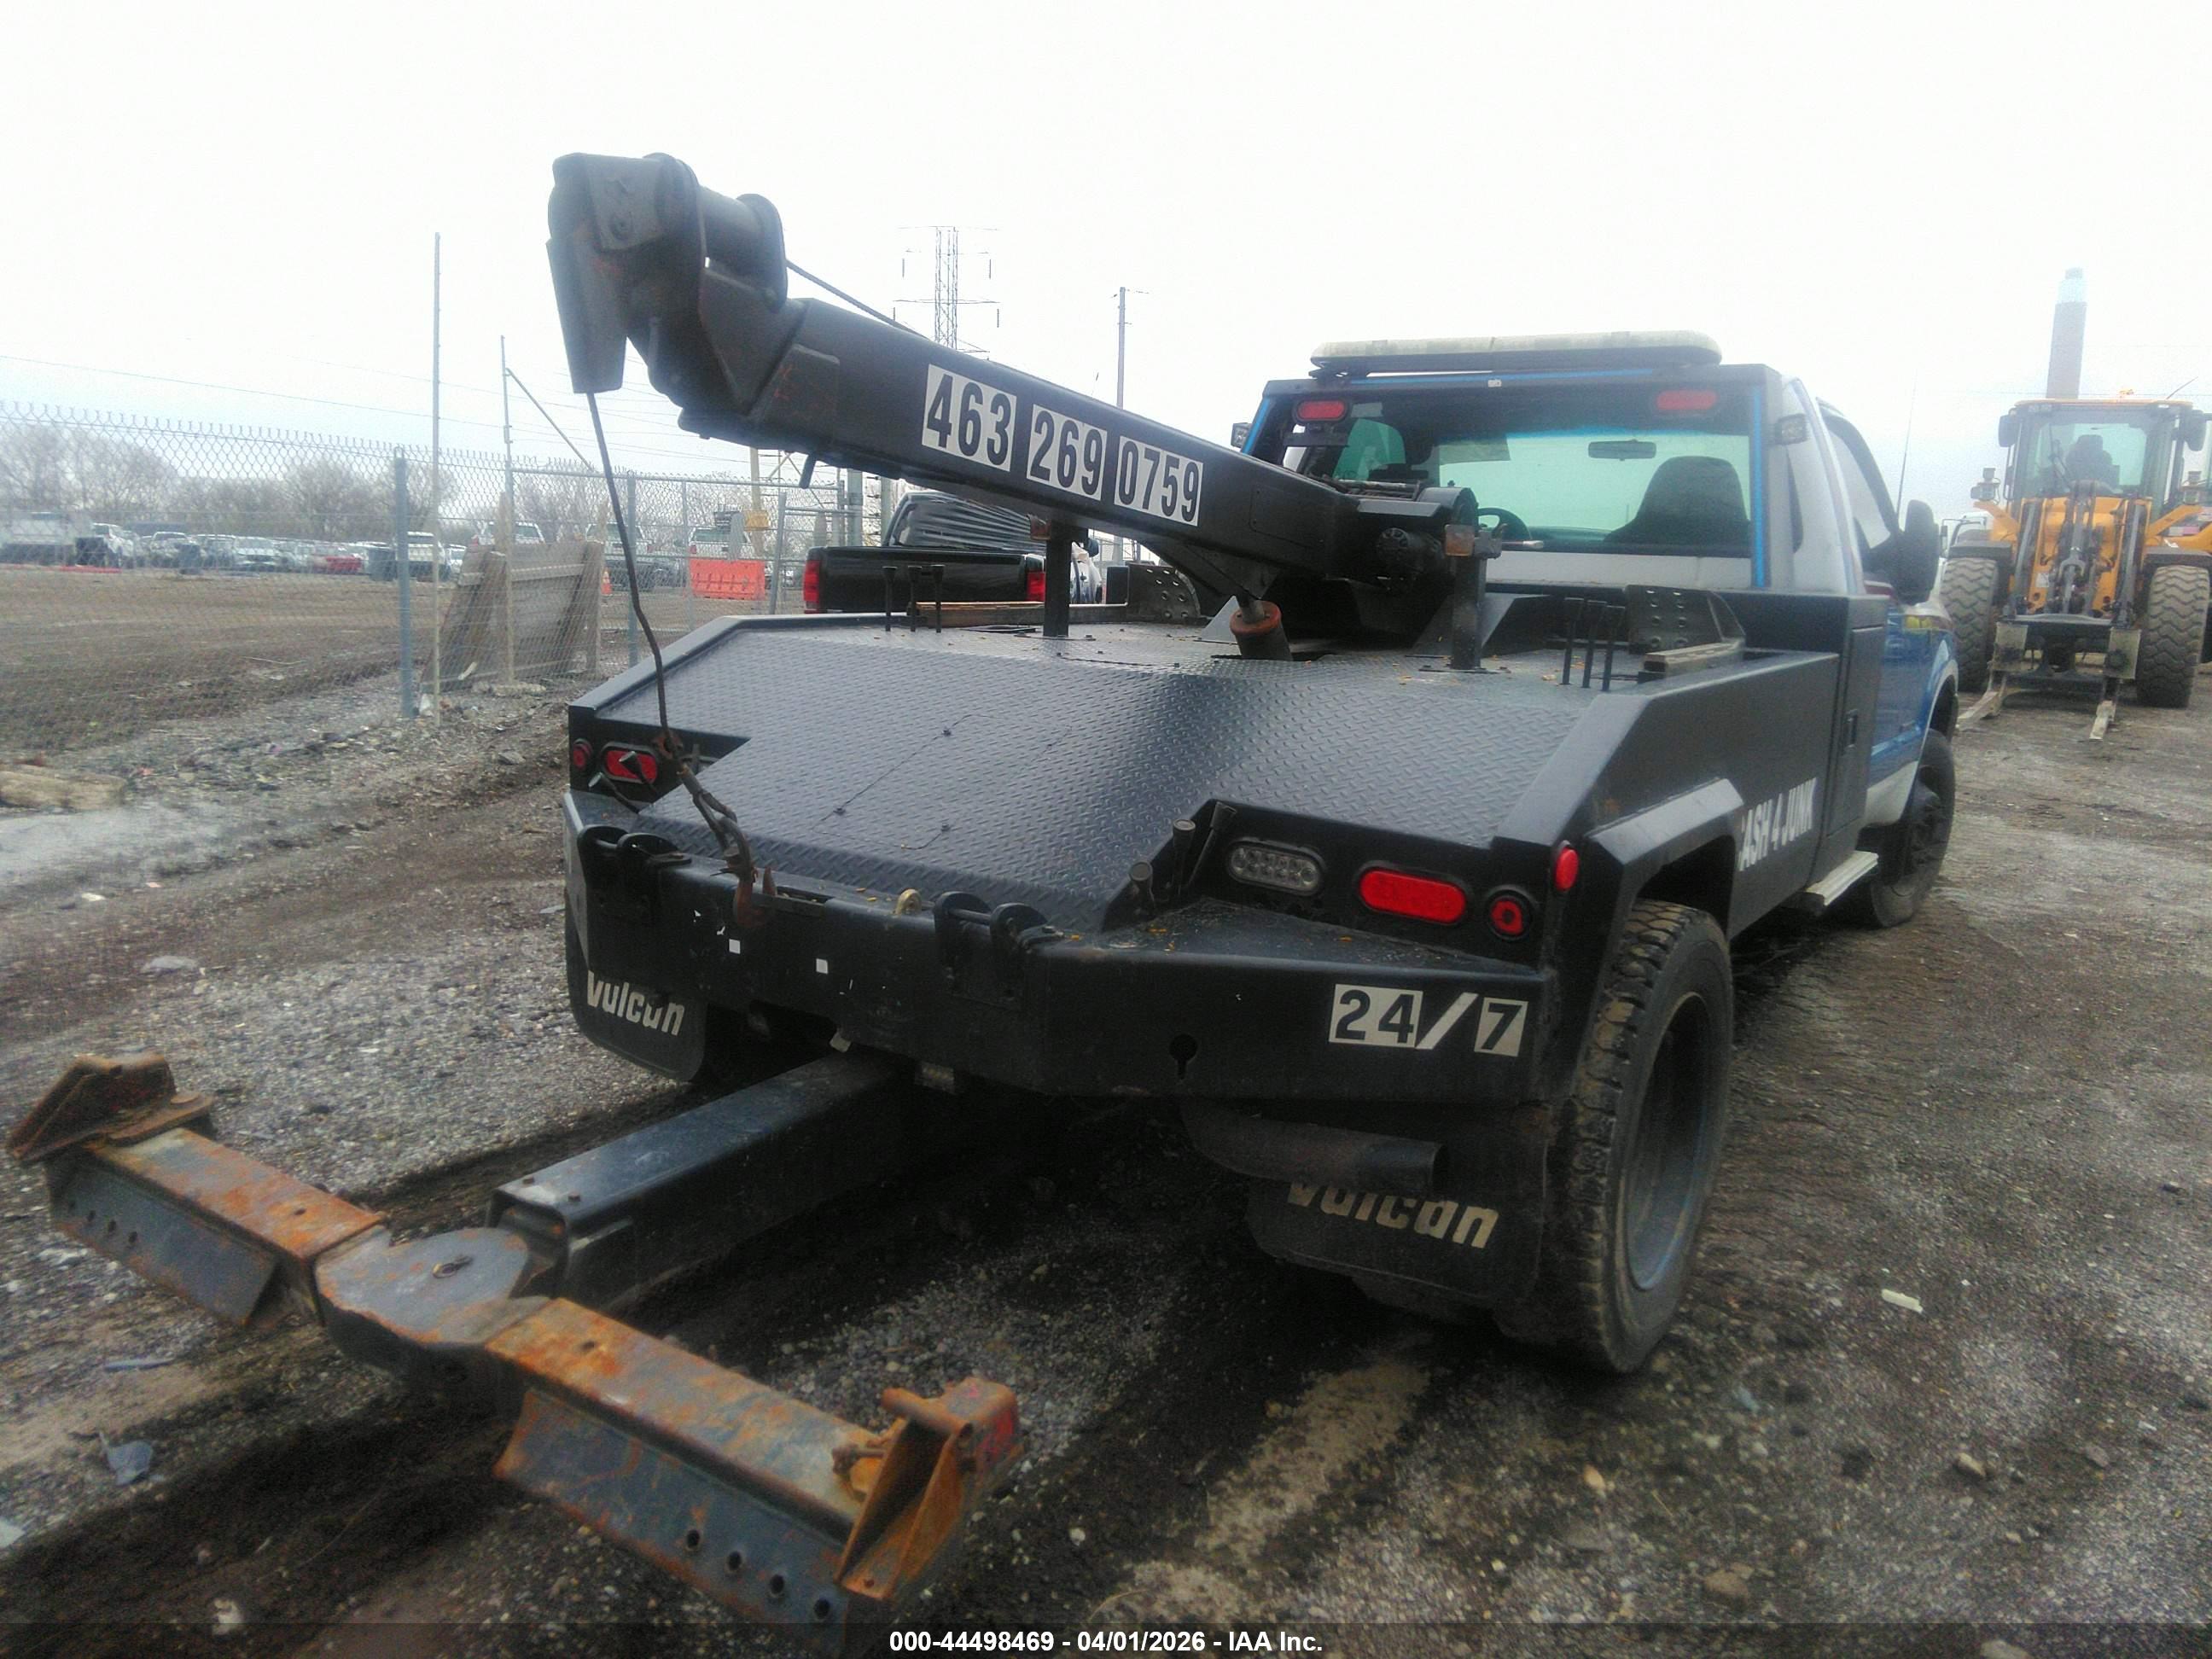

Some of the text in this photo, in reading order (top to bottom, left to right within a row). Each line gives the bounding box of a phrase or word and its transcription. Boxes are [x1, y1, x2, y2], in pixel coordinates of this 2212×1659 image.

[927, 374, 1200, 522] 463 269 0759
[1738, 799, 1773, 871] ASH
[1335, 989, 1522, 1050] 24/7
